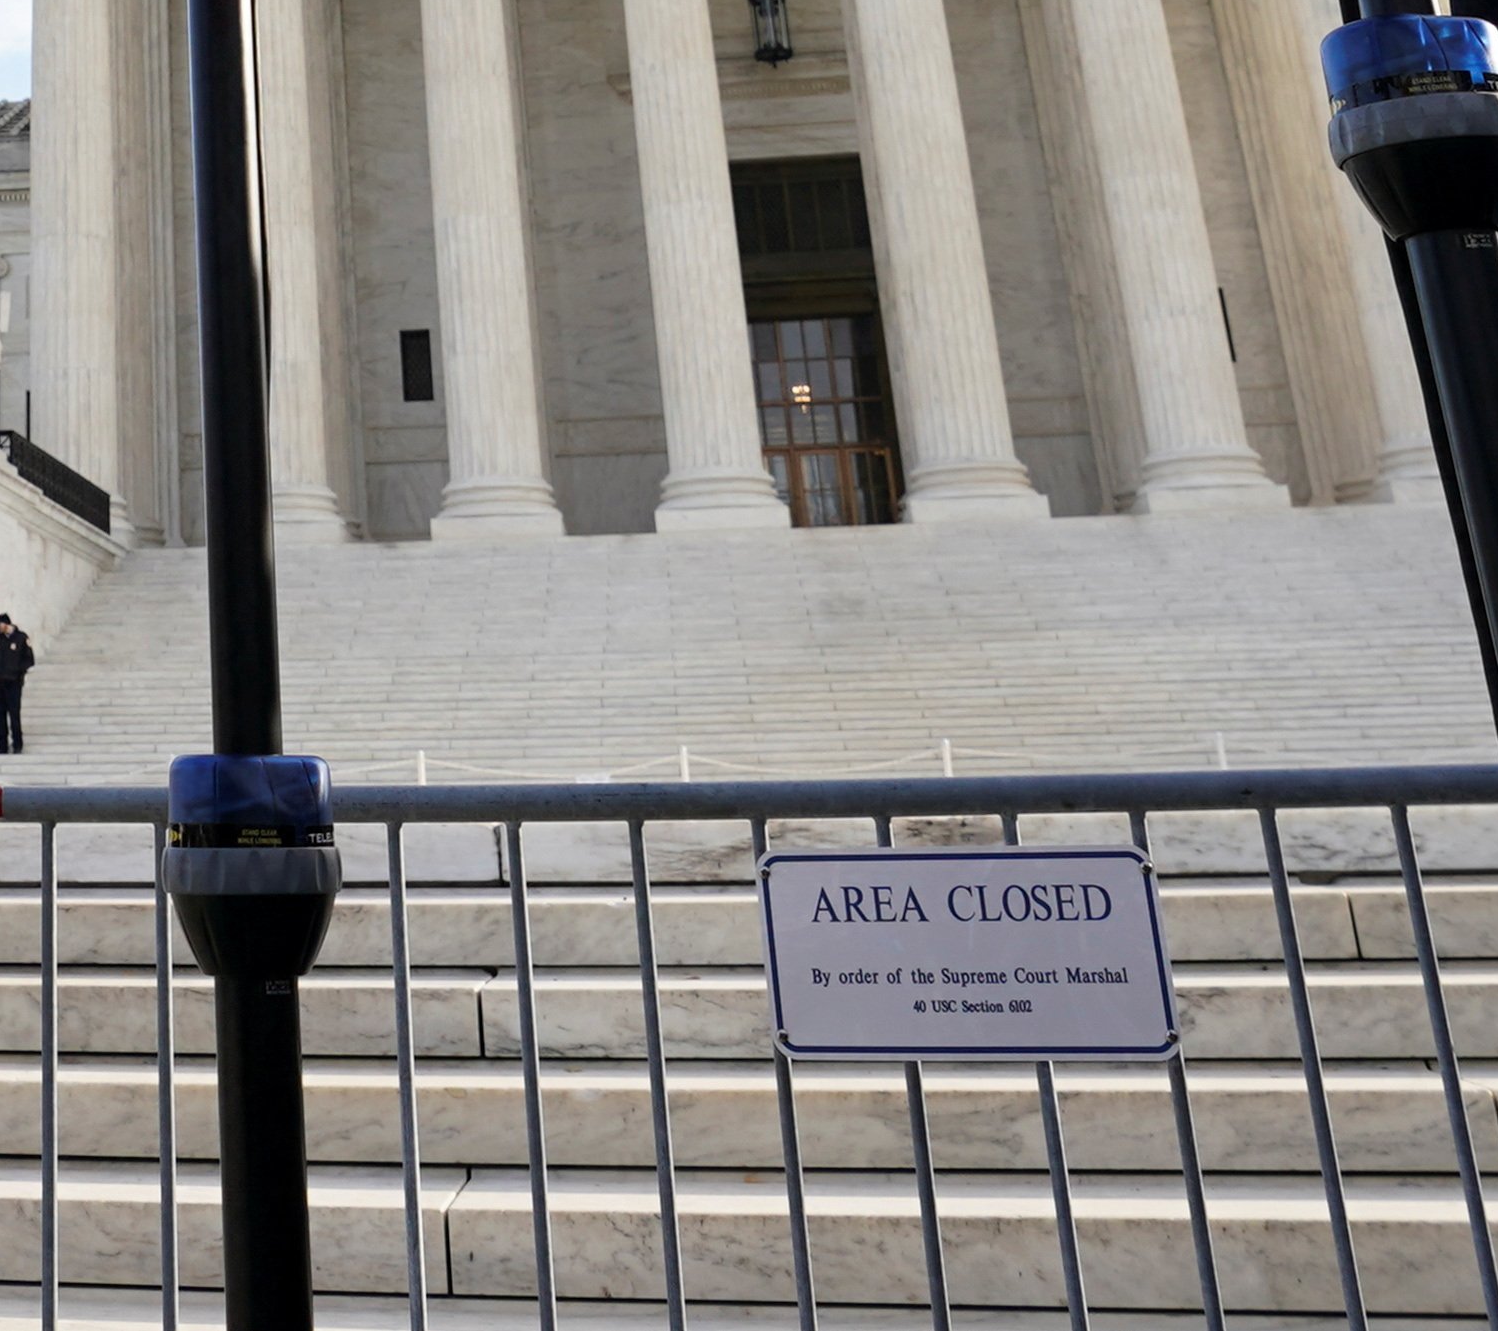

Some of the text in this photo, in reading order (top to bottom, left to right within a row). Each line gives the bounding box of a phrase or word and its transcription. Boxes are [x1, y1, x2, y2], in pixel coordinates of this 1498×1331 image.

[811, 884, 1113, 923] AREA CLOSED
[811, 967, 1130, 988] By order of the Supreme Court Marshal
[913, 1000, 1033, 1014] 40 USC Section 6102
